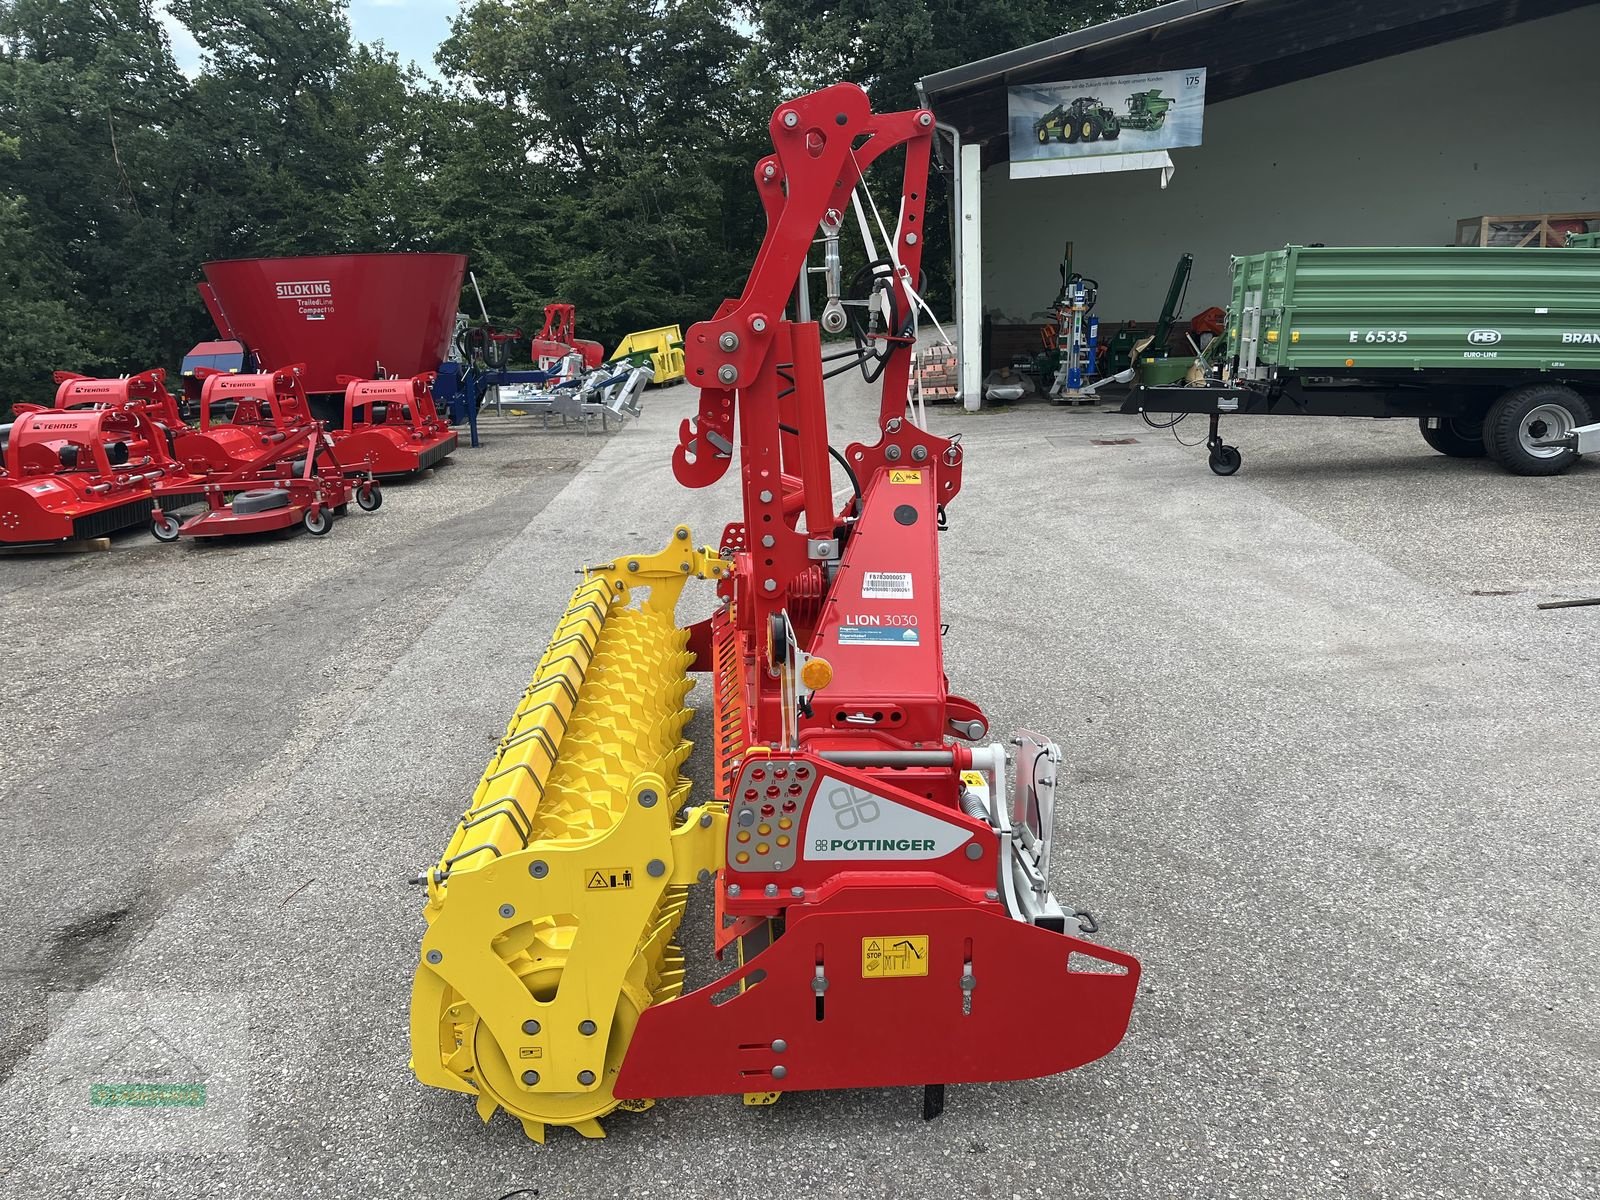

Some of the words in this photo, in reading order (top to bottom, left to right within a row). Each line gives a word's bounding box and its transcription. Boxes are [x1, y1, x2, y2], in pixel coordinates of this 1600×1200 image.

[1185, 76, 1200, 86] 175
[276, 284, 331, 295] SILOKING
[1349, 331, 1358, 342] E
[1365, 331, 1408, 342] 6535
[846, 614, 880, 626] LION
[884, 614, 918, 626] 3030
[831, 839, 935, 851] PÖTTINGER
